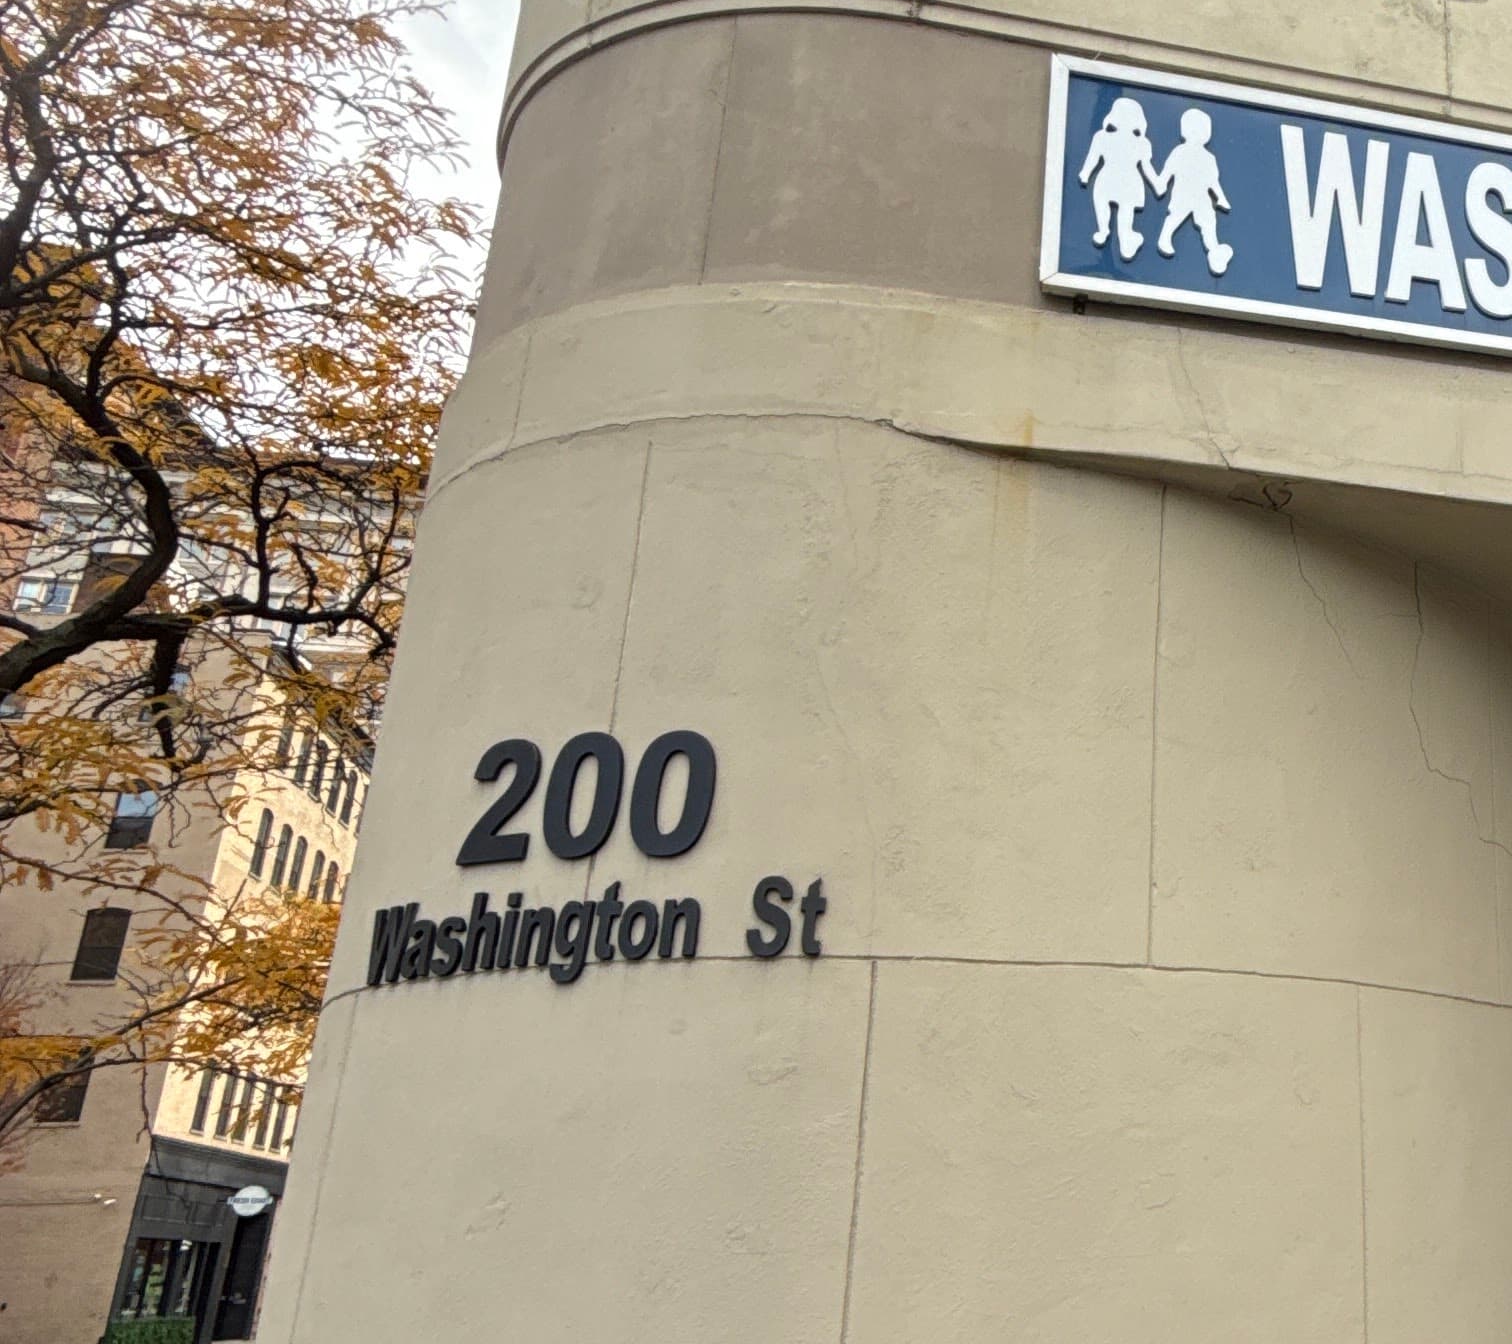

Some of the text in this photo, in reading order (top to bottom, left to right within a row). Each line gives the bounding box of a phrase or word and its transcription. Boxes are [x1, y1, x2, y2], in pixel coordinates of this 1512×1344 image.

[456, 729, 717, 866] 200
[366, 875, 827, 986] Washington St
